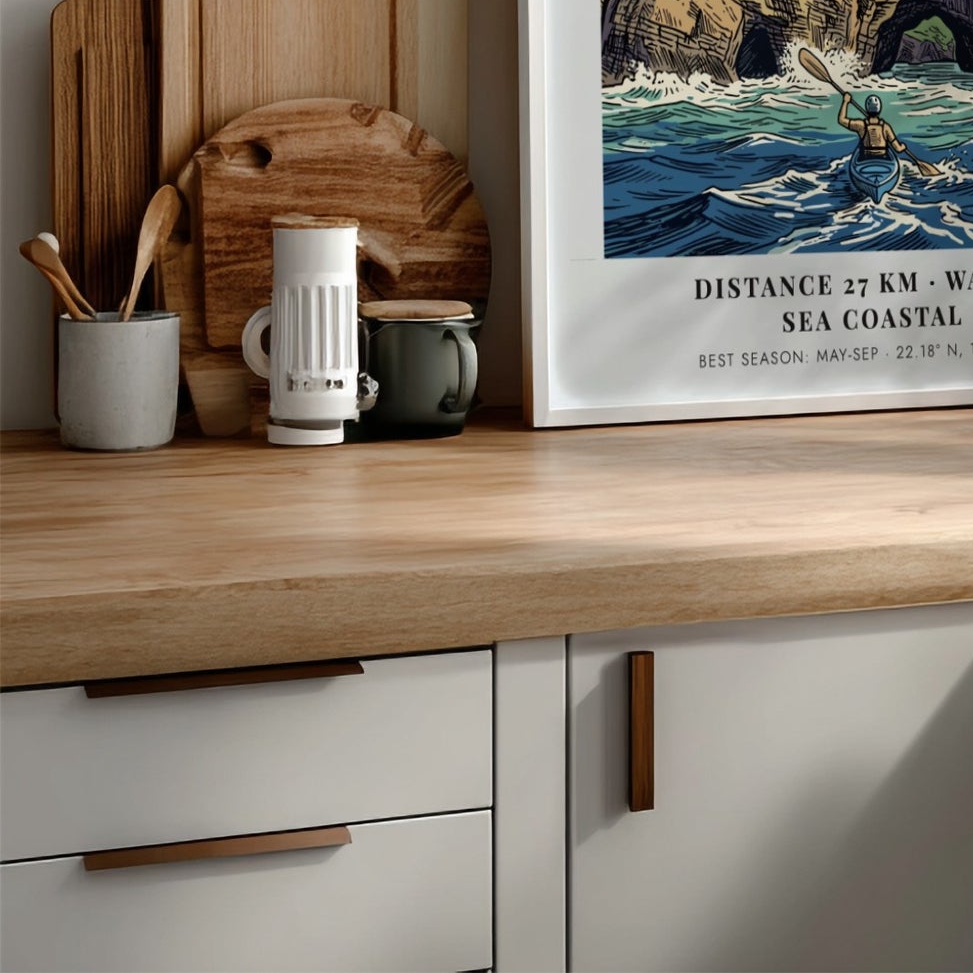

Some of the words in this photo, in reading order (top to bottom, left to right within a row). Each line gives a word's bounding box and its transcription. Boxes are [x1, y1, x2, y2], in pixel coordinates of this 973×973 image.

[695, 274, 832, 300] DISTANCE
[843, 278, 869, 298] 27
[879, 271, 918, 294] KM
[782, 310, 832, 333] SEA
[842, 305, 962, 331] COASTAL
[699, 352, 735, 369] BEST
[741, 350, 809, 367] SEASON:
[816, 346, 879, 363] MAY-SEP
[896, 343, 941, 360] 22.18°
[947, 342, 963, 359] N,
